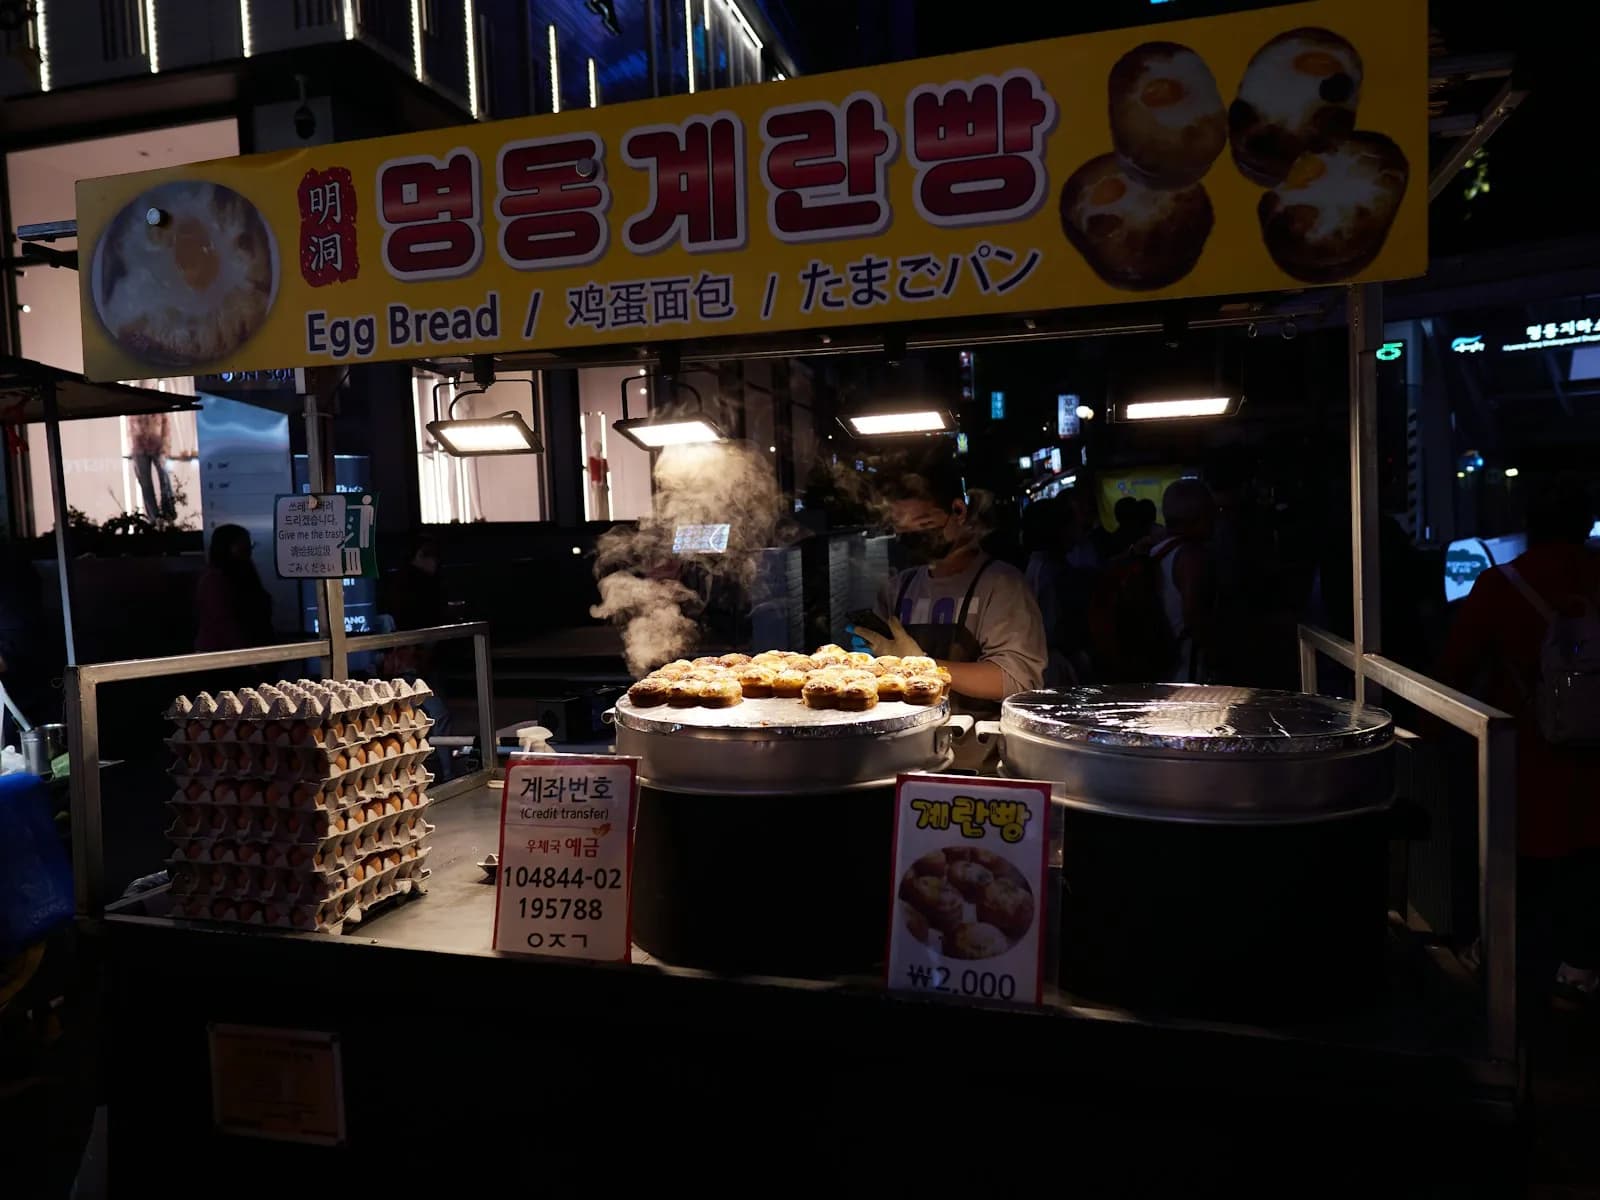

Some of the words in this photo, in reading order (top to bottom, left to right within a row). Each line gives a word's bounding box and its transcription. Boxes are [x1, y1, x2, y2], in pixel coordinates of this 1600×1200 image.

[379, 72, 1050, 277] 명동계란빵
[308, 181, 344, 273] 明洞
[802, 245, 1039, 310] たまごパン
[567, 275, 735, 328] 鸡蛋面包
[308, 312, 375, 357] Egg
[388, 294, 498, 345] Bread
[278, 530, 295, 541] Give
[297, 531, 310, 541] me
[311, 529, 324, 540] the
[520, 776, 614, 803] 계좌번호
[519, 807, 558, 820] (Credit
[561, 807, 609, 820] transfer)
[911, 796, 1032, 843] 계란빵
[526, 839, 561, 854] 우체국
[564, 837, 600, 858] 예금
[504, 866, 622, 889] 104844-02
[519, 897, 603, 920] 195788
